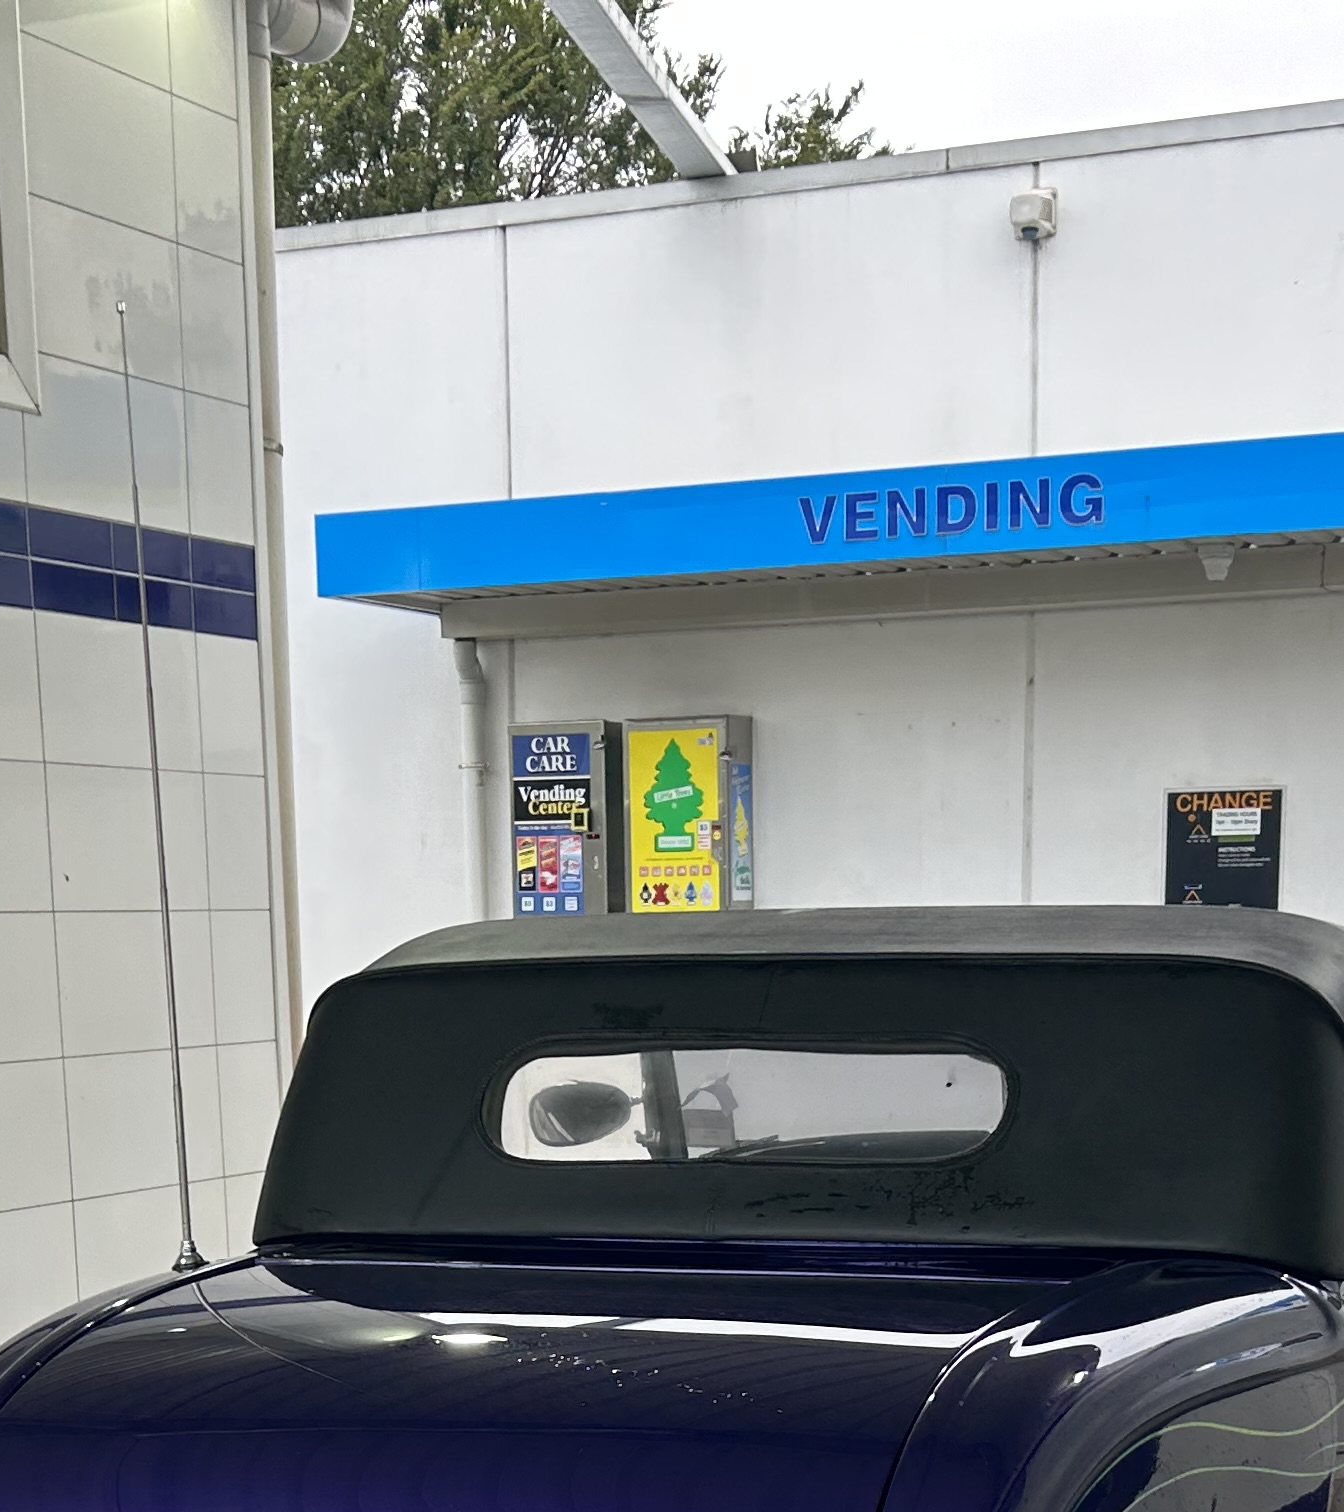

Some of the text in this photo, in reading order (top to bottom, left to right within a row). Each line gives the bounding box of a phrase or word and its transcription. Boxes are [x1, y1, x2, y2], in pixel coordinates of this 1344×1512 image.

[798, 472, 1104, 545] VENDING
[531, 736, 570, 754] CAR
[525, 754, 578, 773] CARE
[518, 784, 586, 805] Vending
[1175, 791, 1274, 813] CHANGE
[528, 799, 580, 816] Center
